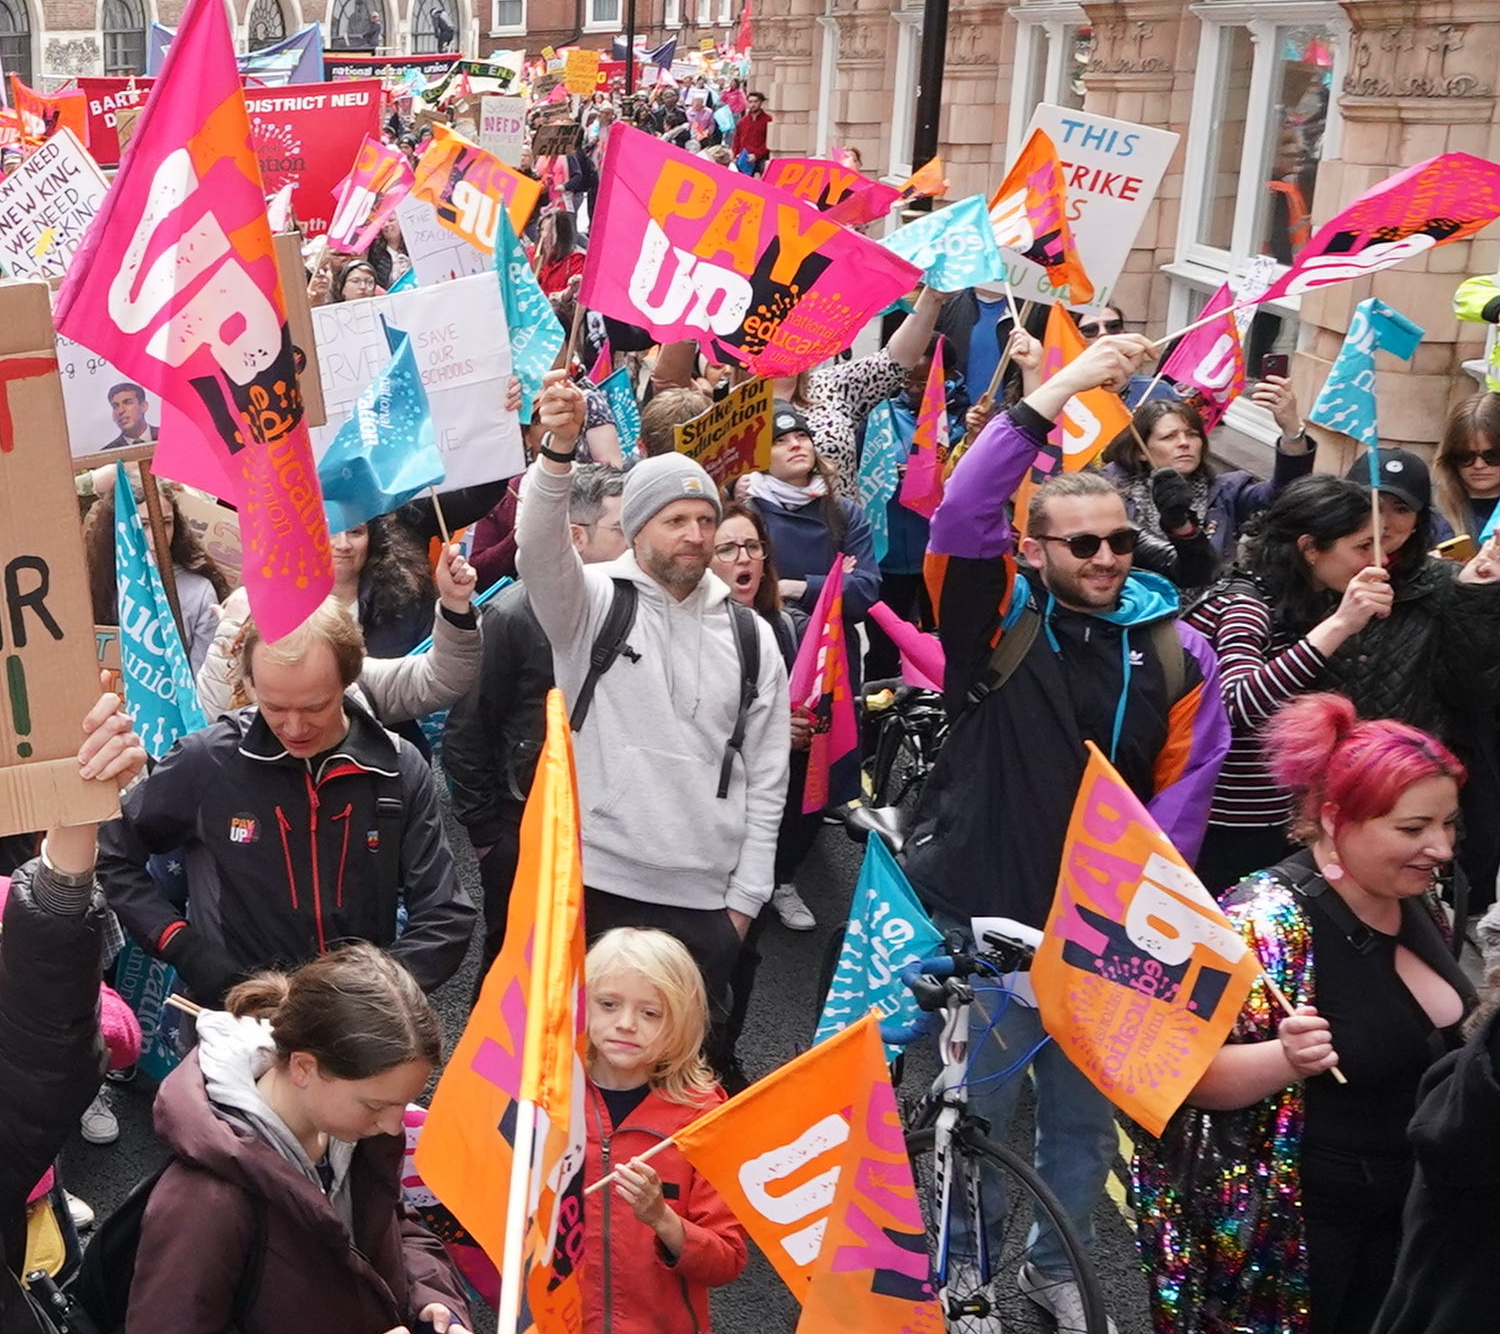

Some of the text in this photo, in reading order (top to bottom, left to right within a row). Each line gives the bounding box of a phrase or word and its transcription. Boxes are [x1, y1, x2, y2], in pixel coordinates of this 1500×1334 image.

[331, 65, 372, 76] national
[461, 61, 516, 80] REENS
[330, 91, 370, 108] NEU
[483, 115, 521, 134] NEED
[1060, 118, 1141, 157] THIS
[25, 142, 60, 180] NEED
[35, 156, 82, 202] KING
[259, 154, 306, 172] ation
[774, 163, 859, 206] PAY
[1059, 160, 1144, 202] RIKE
[5, 226, 36, 256] WE
[33, 187, 80, 234] NEED
[648, 157, 843, 287] PAY
[11, 260, 29, 278] A
[105, 147, 283, 387] UP
[627, 217, 754, 337] UP
[416, 323, 460, 349] SAVE
[420, 358, 474, 386] SCHOOLS
[428, 345, 455, 366] OUR
[681, 377, 768, 447] Strike for
[230, 817, 256, 829] PAY
[140, 957, 169, 1054] cation
